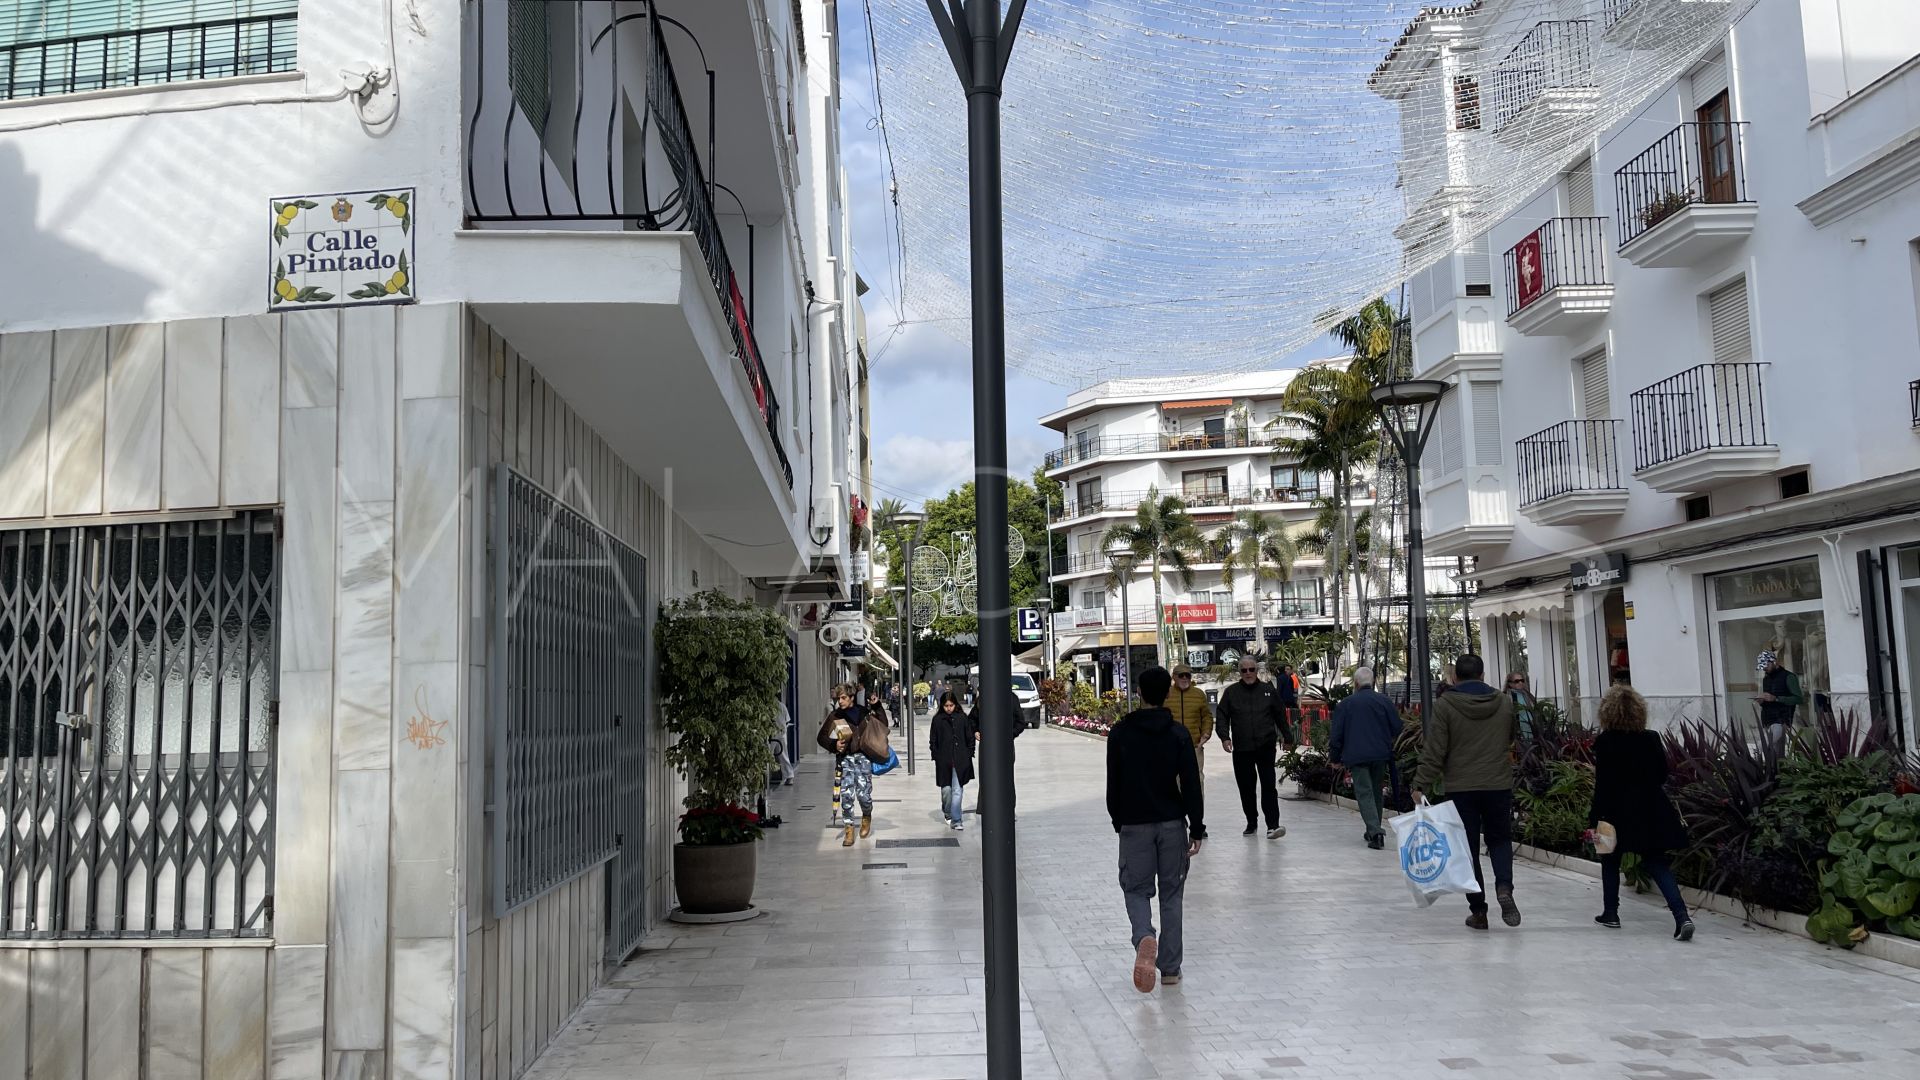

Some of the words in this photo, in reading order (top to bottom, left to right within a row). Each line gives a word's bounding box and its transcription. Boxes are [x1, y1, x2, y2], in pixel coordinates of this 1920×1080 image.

[307, 229, 378, 253] Calle
[287, 250, 395, 275] Pintado
[1747, 577, 1801, 594] DANDARA
[1025, 610, 1040, 628] P
[1178, 608, 1214, 618] GENERALI
[1226, 628, 1248, 638] MAGIC
